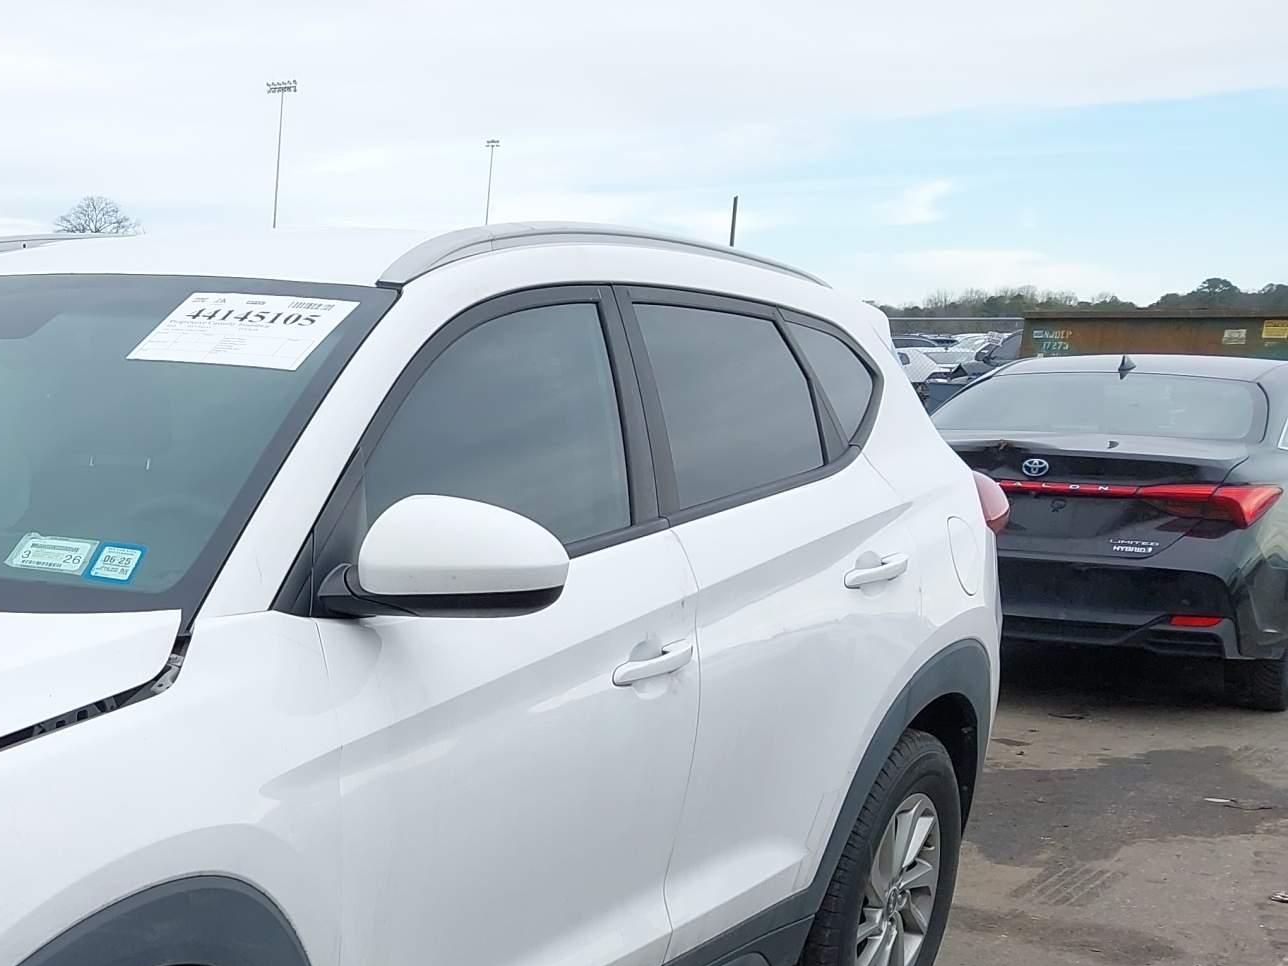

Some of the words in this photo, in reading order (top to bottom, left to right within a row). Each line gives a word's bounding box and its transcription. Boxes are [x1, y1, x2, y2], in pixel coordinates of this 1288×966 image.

[185, 307, 322, 327] 44145105
[1112, 545, 1146, 553] HYBRID
[21, 550, 32, 559] 3
[62, 554, 82, 565] 26
